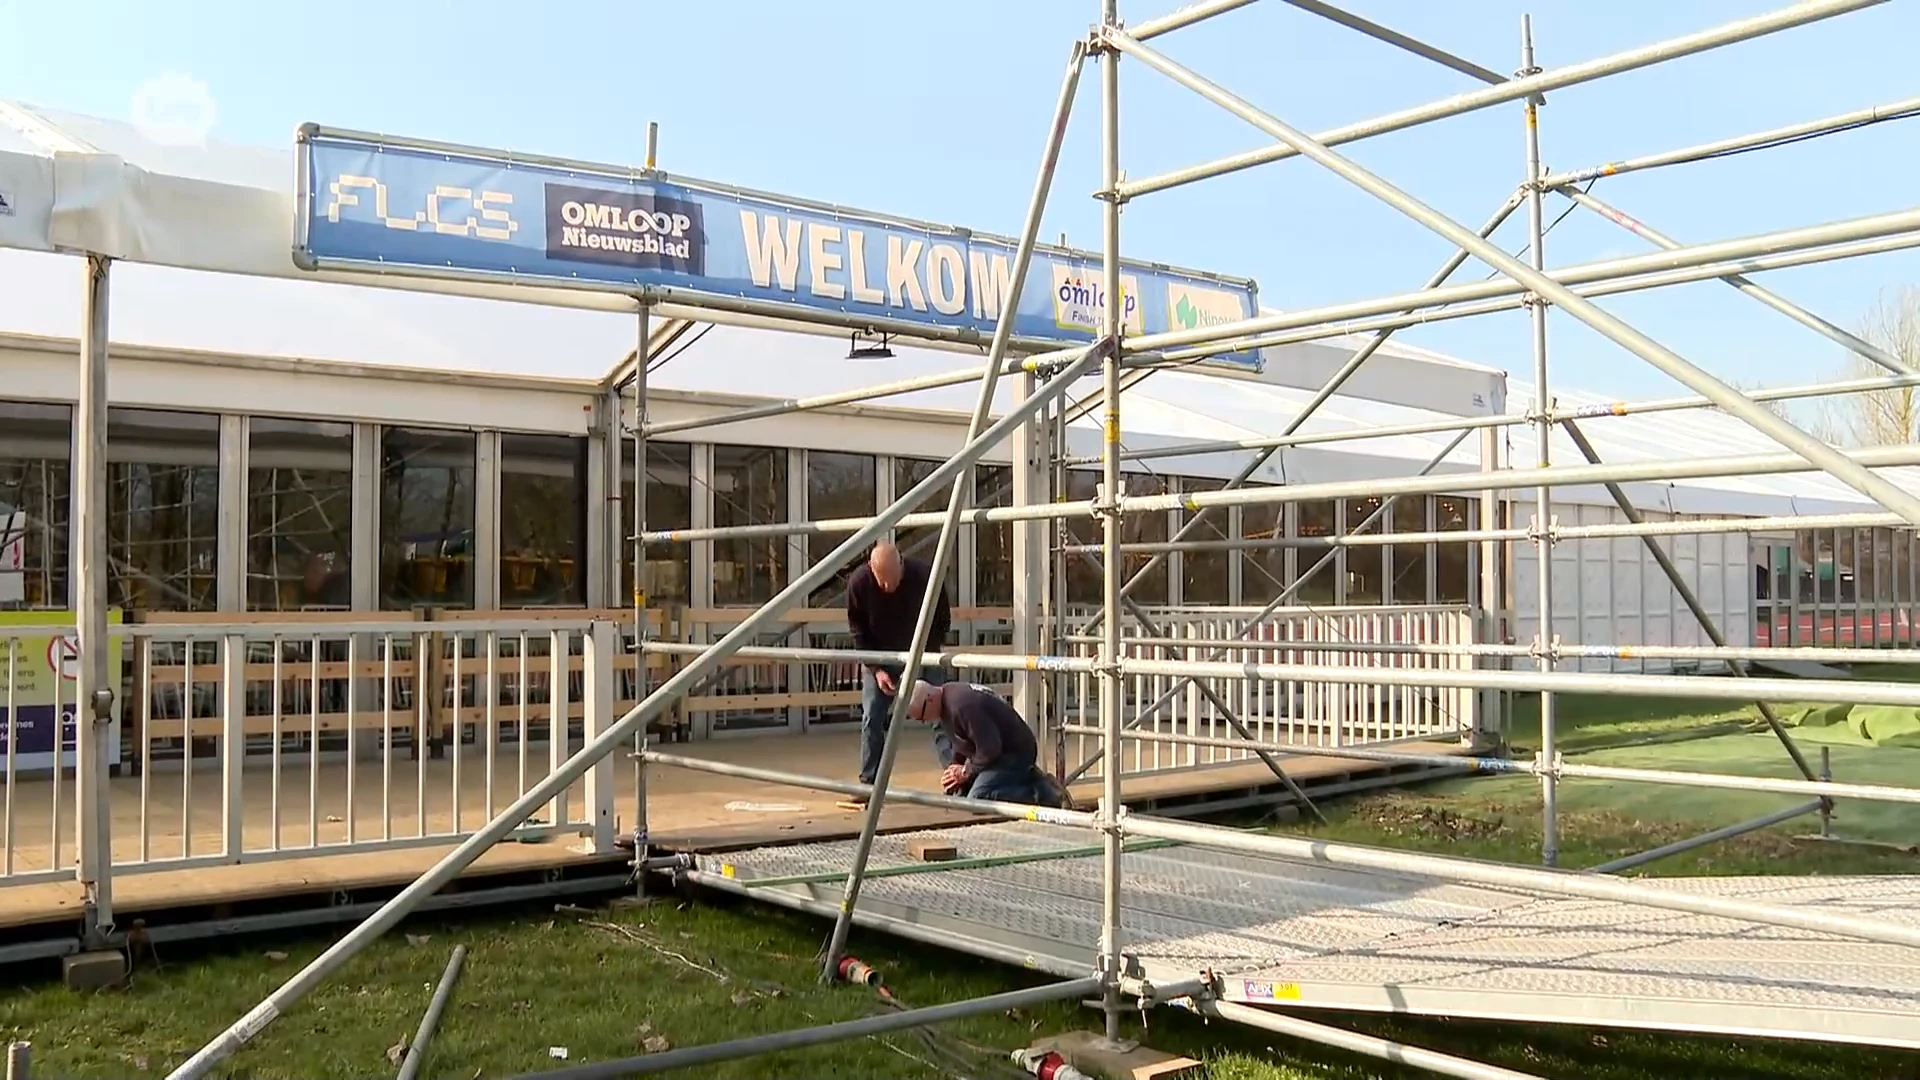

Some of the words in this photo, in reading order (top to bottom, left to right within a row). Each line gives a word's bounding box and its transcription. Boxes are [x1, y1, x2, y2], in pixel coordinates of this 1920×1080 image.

[328, 174, 519, 241] FLCS
[561, 200, 690, 238] OMLOOP
[561, 226, 690, 260] Nieuwsblad
[740, 209, 1011, 321] WELKOM
[1059, 283, 1136, 318] omlp
